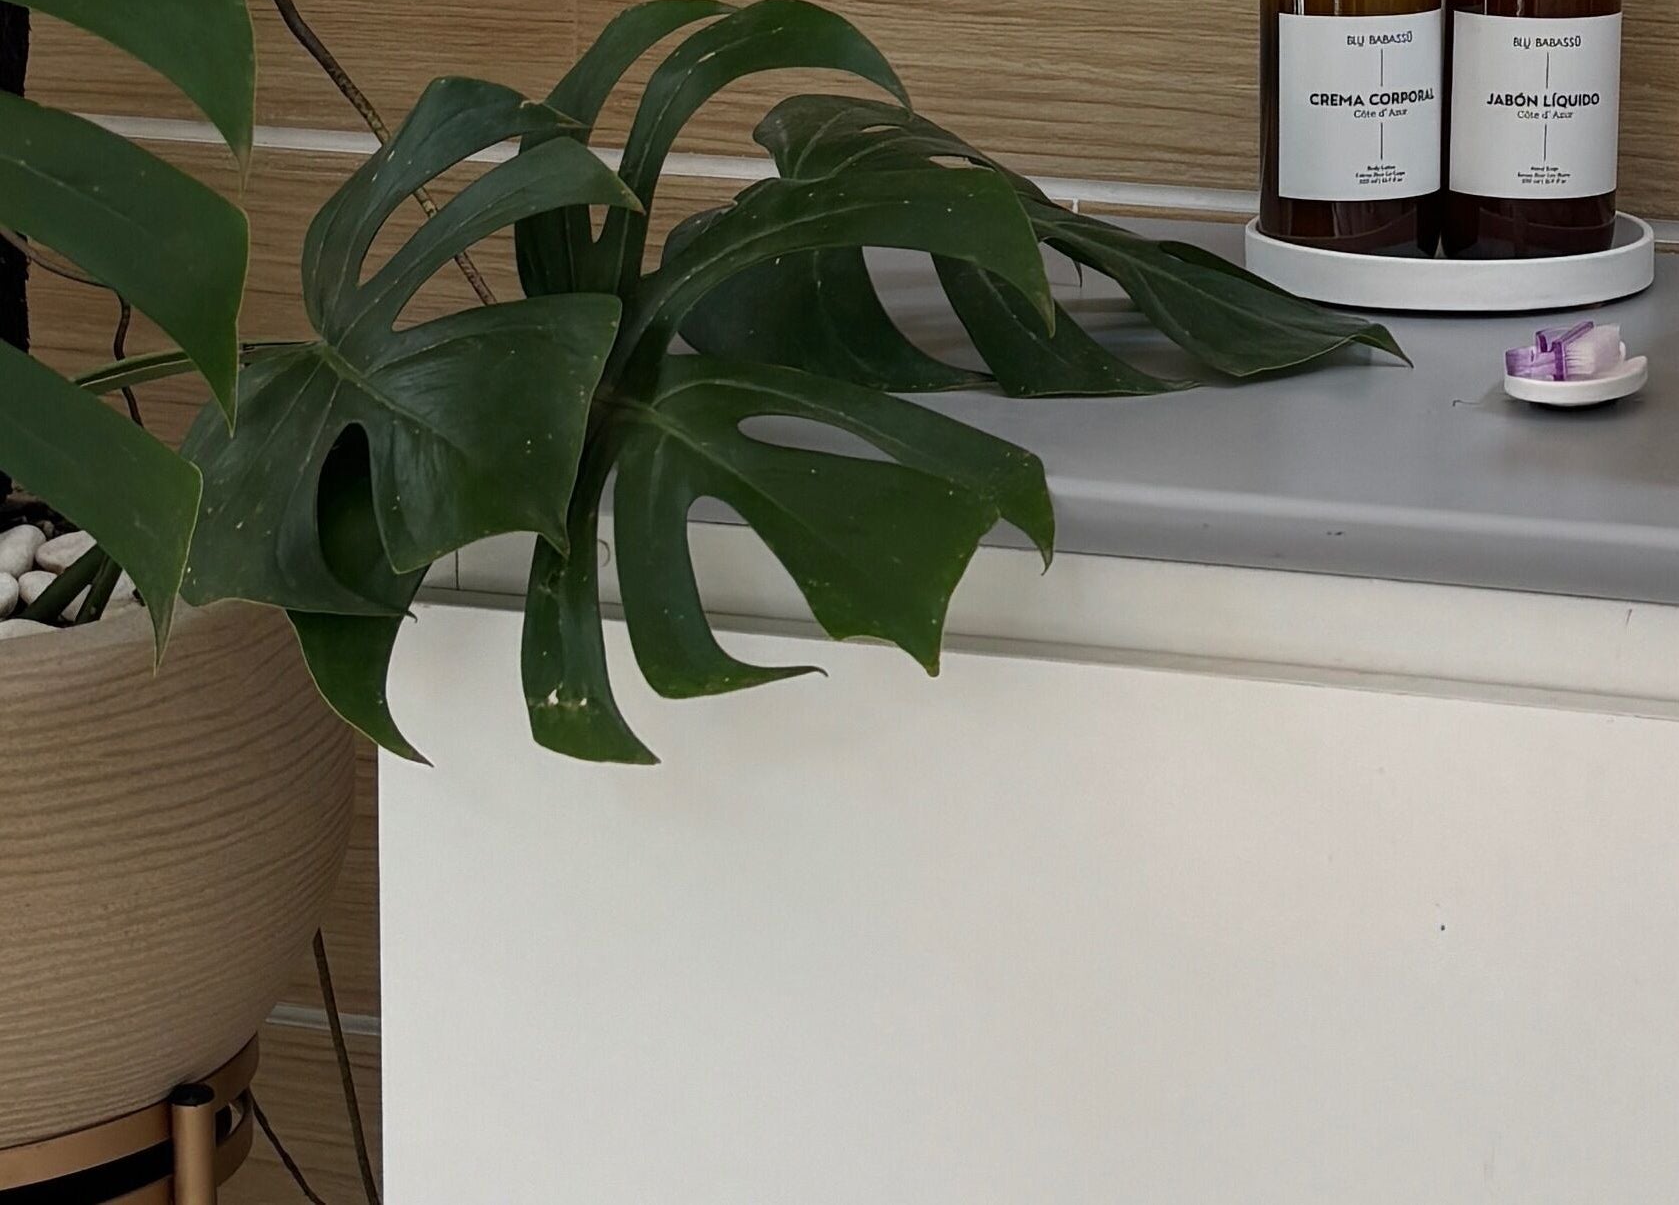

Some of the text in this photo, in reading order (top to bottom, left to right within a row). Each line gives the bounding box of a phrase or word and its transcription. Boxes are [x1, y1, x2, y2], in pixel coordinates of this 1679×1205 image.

[1309, 88, 1435, 106] CREMA CORPORAL
[1486, 92, 1600, 108] JABÓN LÍQUIDO
